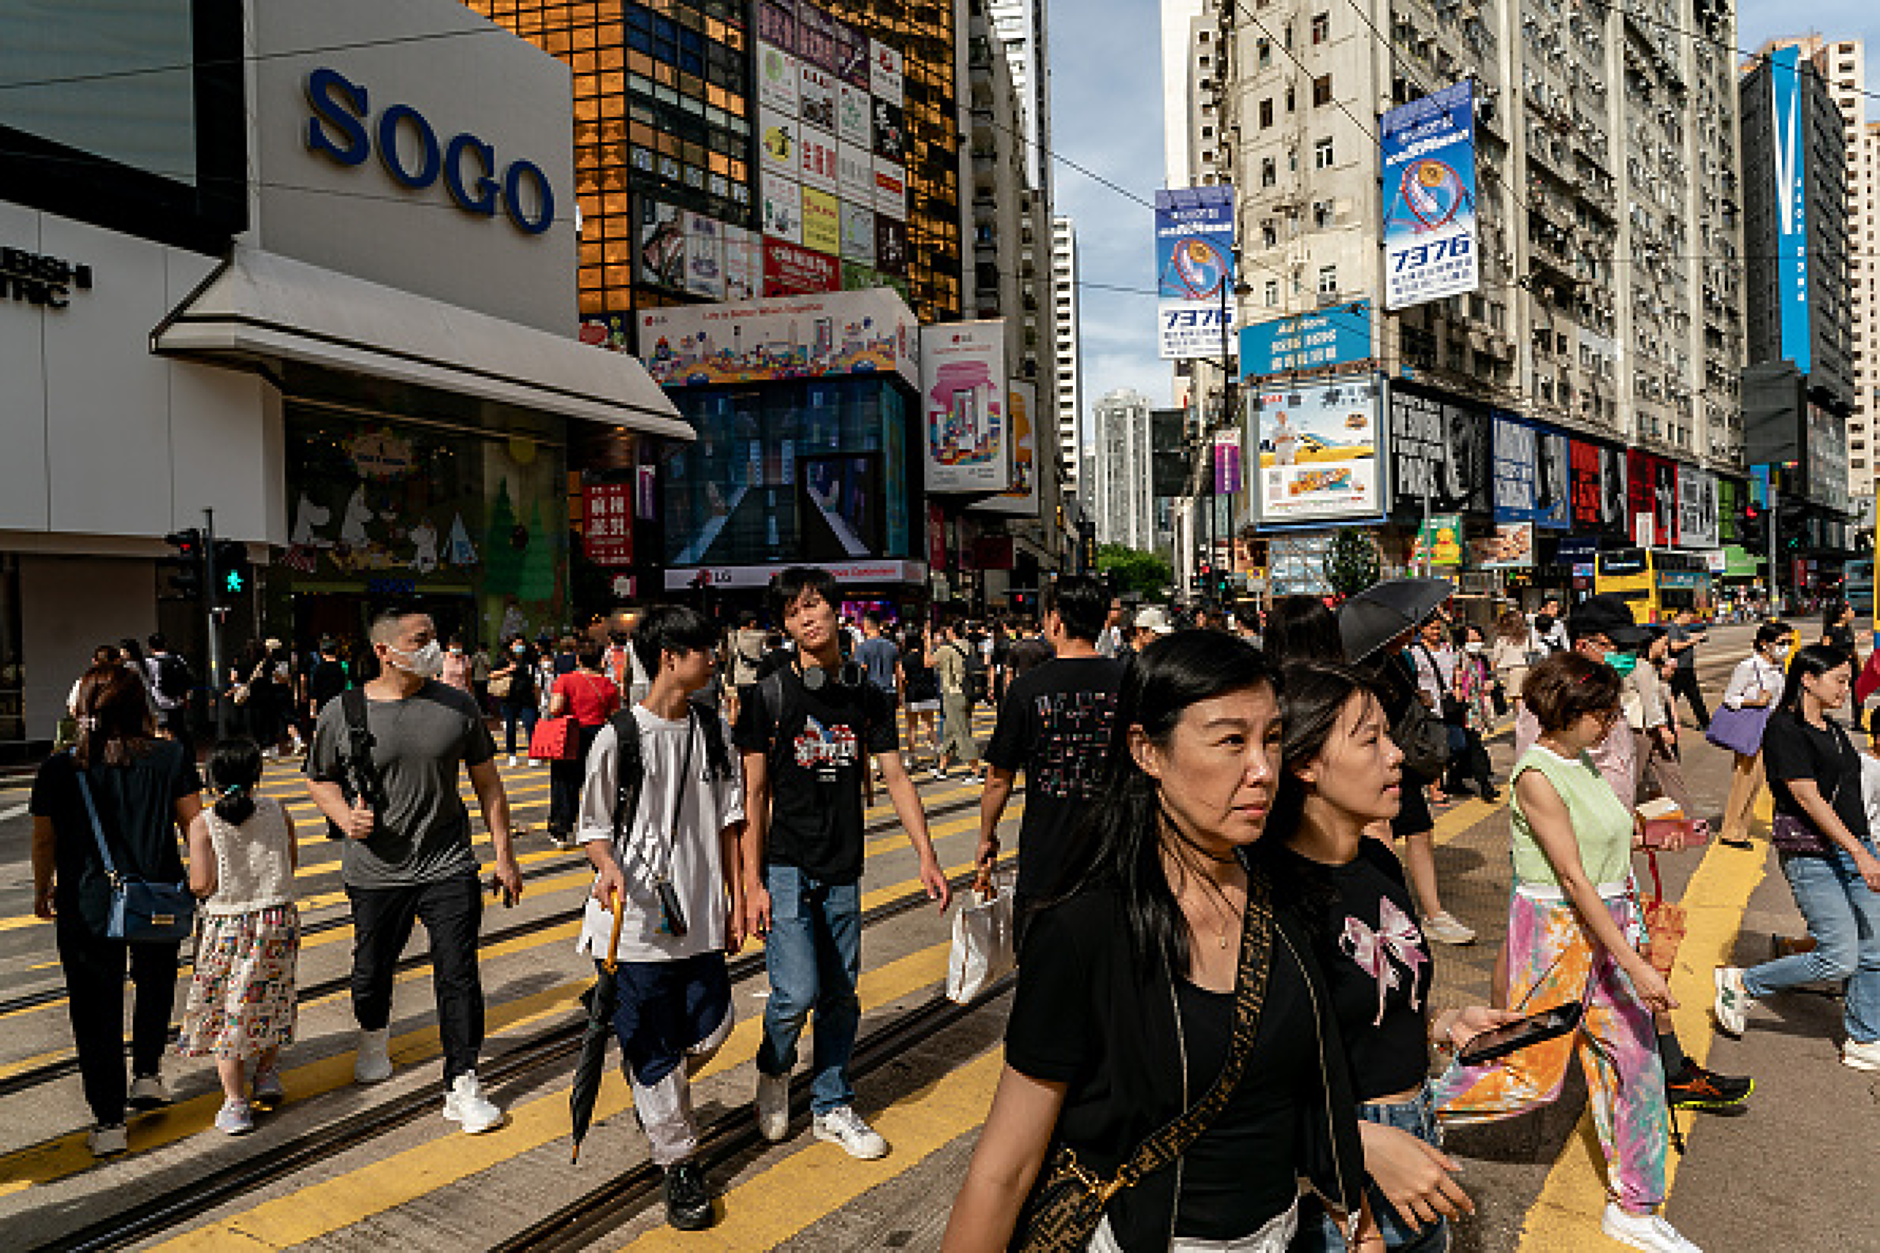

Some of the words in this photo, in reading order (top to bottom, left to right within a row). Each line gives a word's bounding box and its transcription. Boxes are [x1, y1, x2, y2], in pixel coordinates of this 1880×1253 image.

[309, 67, 554, 235] SOGO
[1391, 234, 1470, 272] 7376
[714, 569, 732, 583] LG
